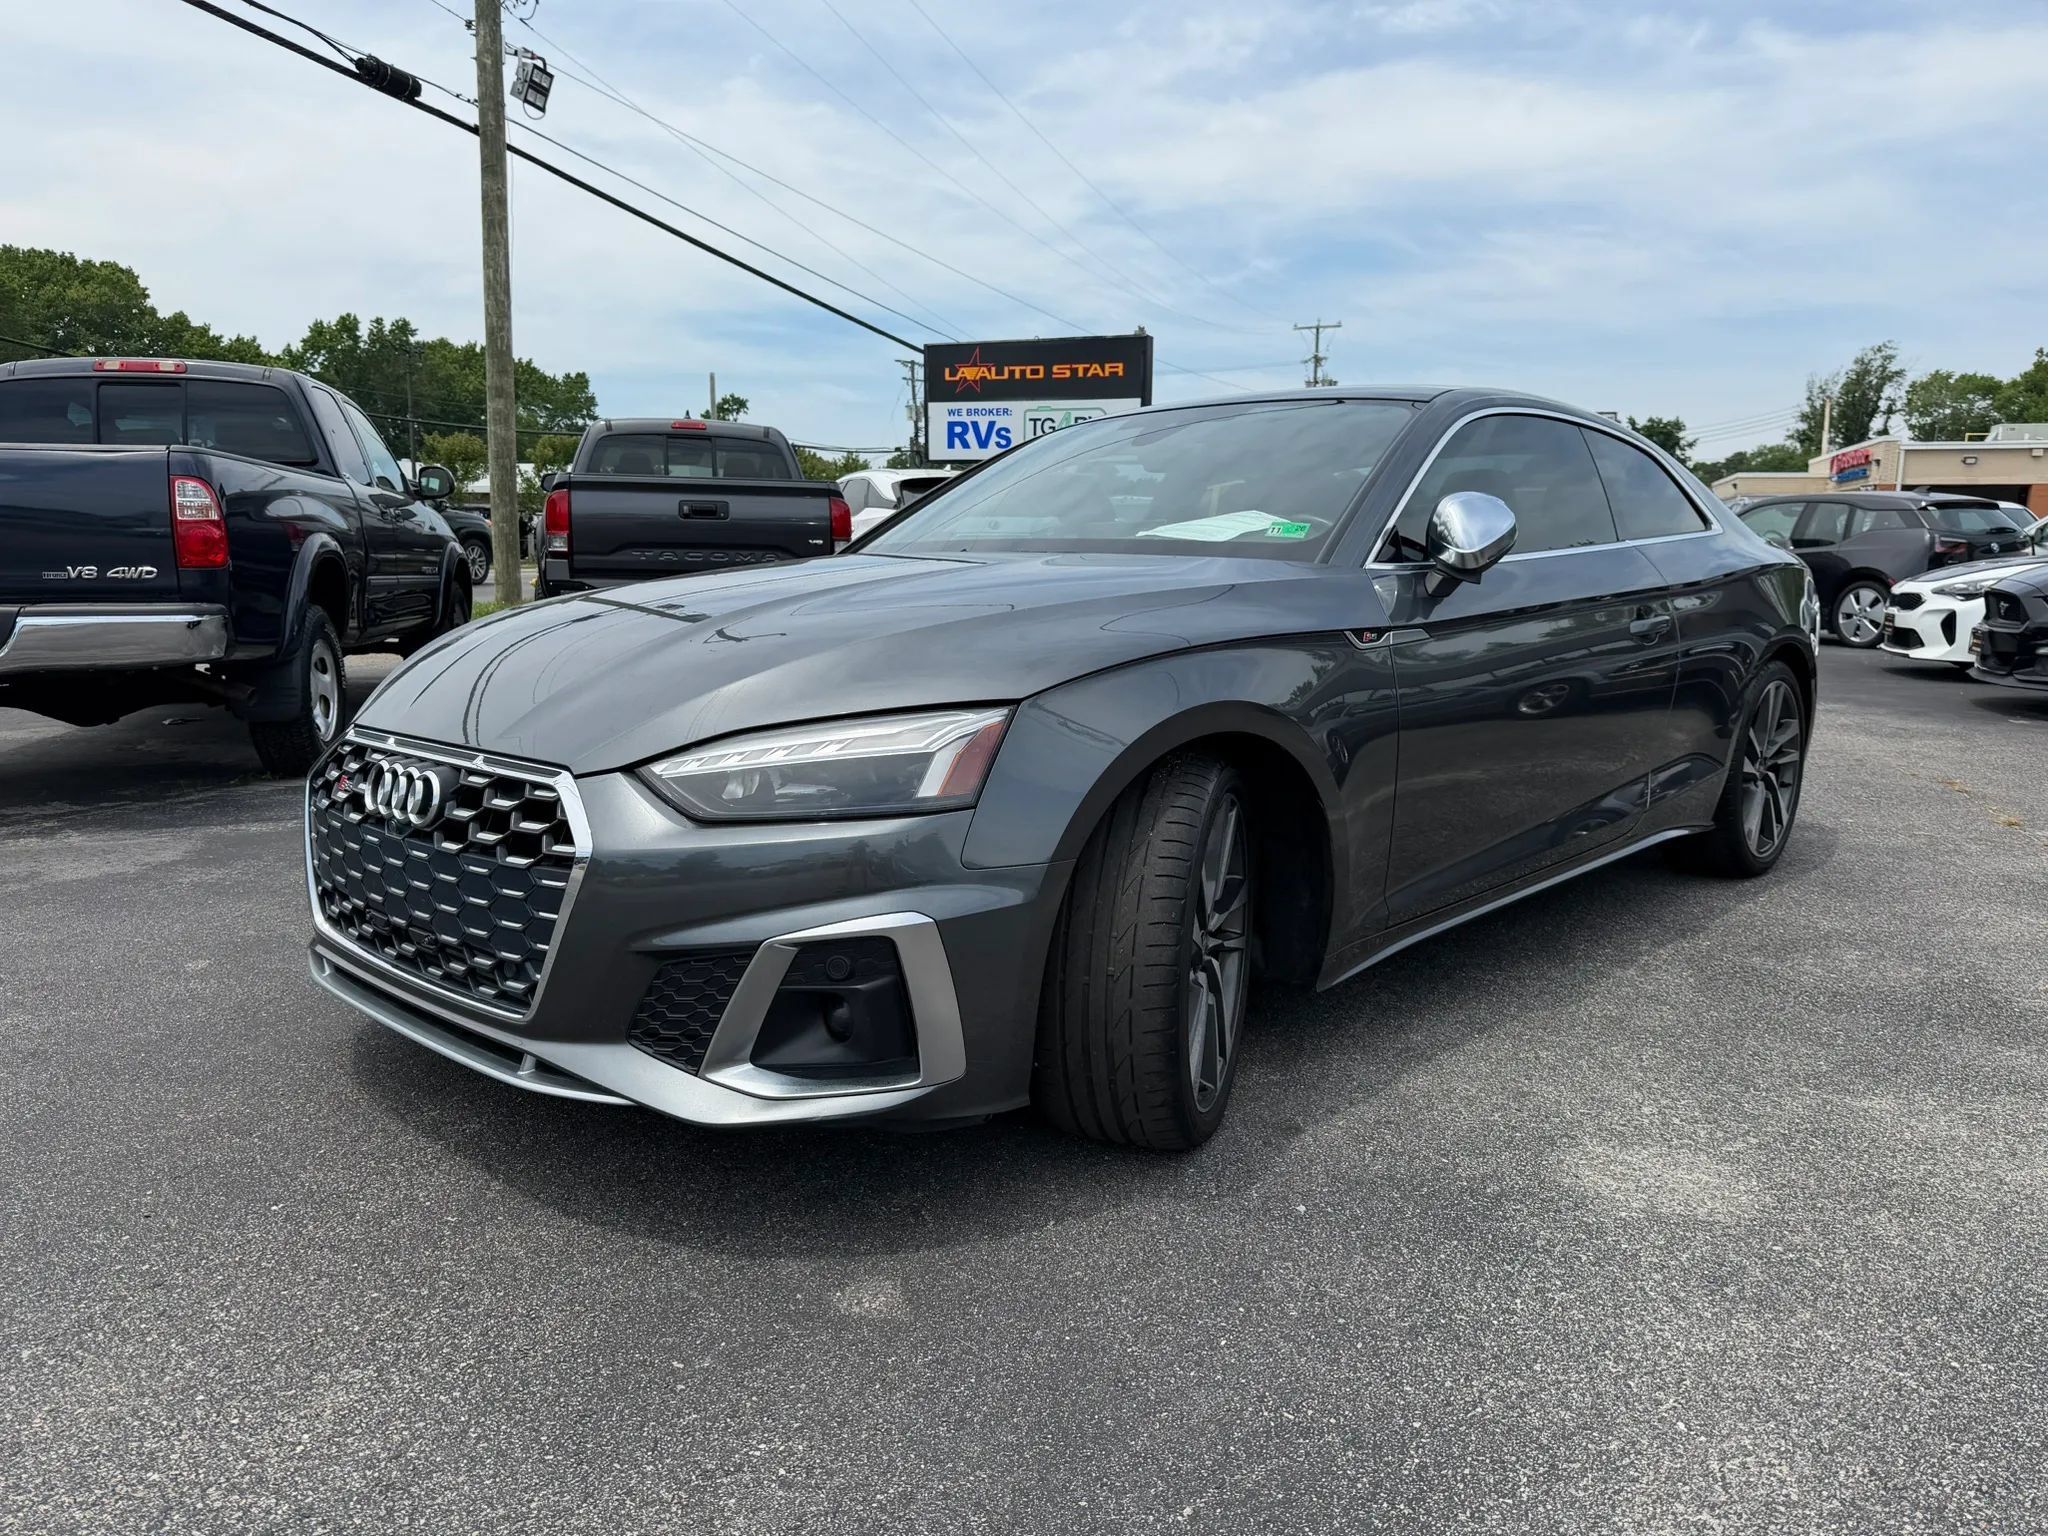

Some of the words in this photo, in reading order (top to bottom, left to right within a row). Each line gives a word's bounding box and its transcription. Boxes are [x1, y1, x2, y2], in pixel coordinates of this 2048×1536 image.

[945, 366, 967, 380] LA
[976, 365, 1044, 380] AUTO
[1052, 363, 1124, 378] STAR
[947, 408, 963, 417] WE
[966, 407, 1013, 417] BROKER:
[947, 421, 1012, 449] RVs
[631, 551, 780, 562] TACOMA
[67, 566, 98, 579] V8
[106, 566, 158, 579] 4WD
